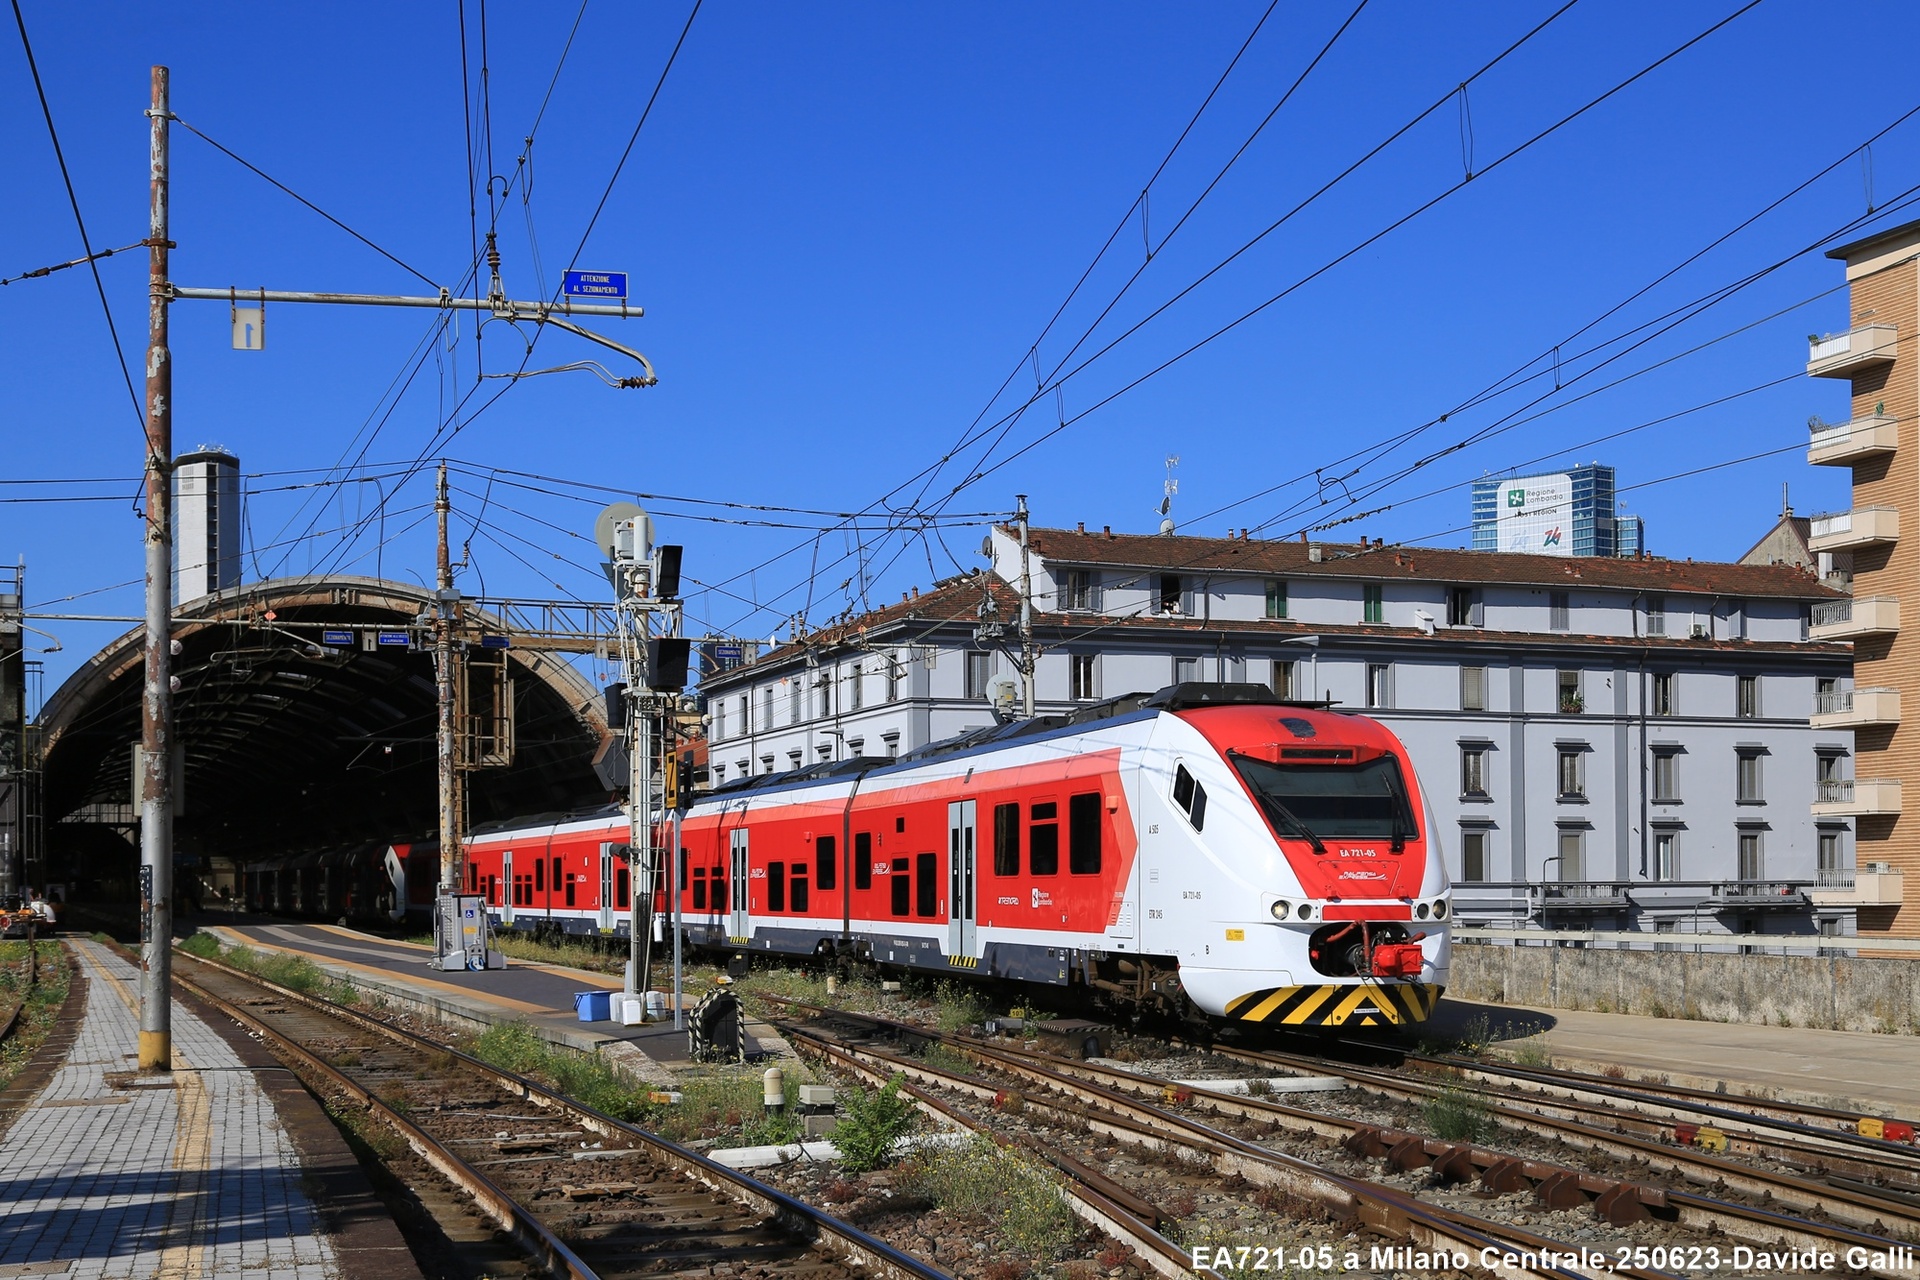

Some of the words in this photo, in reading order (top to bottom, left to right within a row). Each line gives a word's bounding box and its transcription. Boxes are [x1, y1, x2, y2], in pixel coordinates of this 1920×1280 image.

[580, 274, 610, 283] ATTENZIONE
[573, 285, 580, 293] AL
[582, 285, 618, 294] SEZIONAMENTO
[1526, 489, 1555, 497] Regione
[1526, 494, 1563, 504] Lombardia
[1534, 509, 1556, 517] REGION
[1340, 849, 1350, 857] EA
[1351, 849, 1376, 857] 721-05
[1182, 891, 1188, 899] EA
